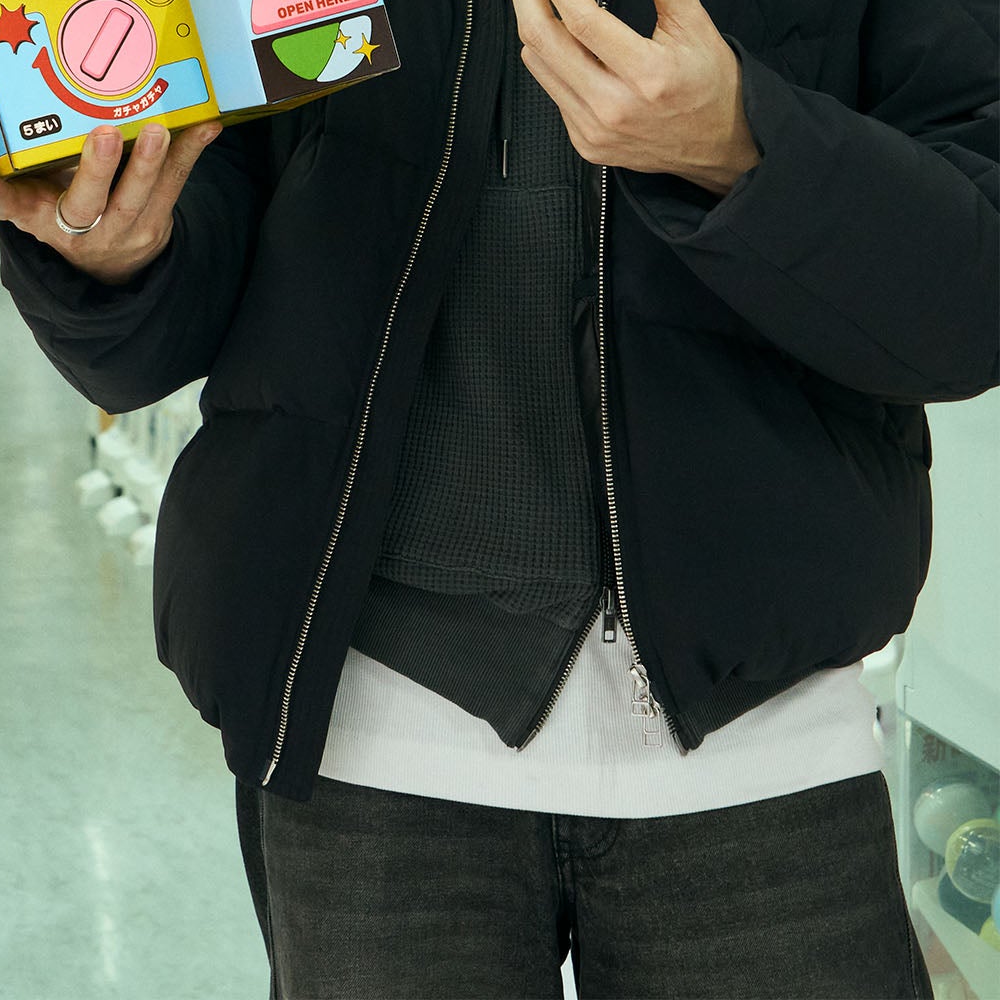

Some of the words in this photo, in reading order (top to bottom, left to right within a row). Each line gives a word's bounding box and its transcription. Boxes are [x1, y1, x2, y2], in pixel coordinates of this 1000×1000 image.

[277, 0, 314, 19] OPEN
[113, 85, 162, 118] ガチャガチャ
